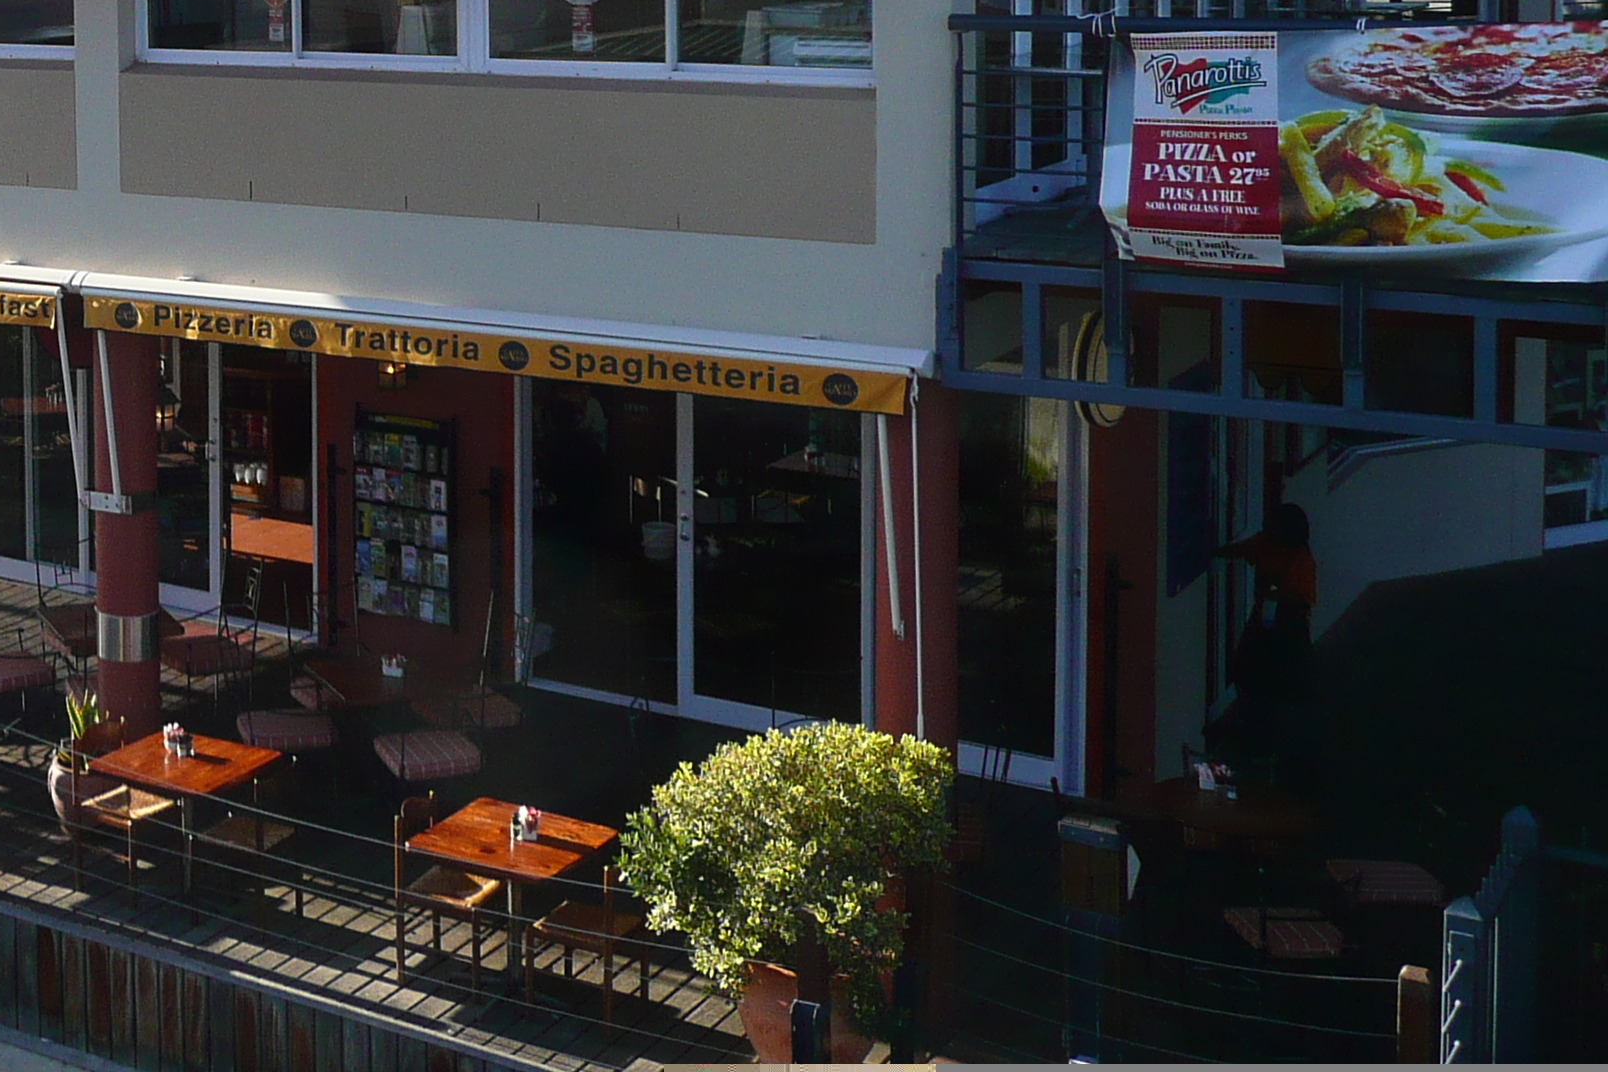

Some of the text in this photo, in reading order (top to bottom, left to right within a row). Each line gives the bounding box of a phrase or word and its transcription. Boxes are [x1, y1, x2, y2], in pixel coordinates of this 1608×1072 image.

[1144, 53, 1262, 104] Panarottis
[1160, 130, 1249, 141] PENSIONER'S PERKS
[1158, 142, 1256, 163] PIZZA or
[1143, 163, 1224, 184] PASTA
[1160, 187, 1246, 203] PLUS A FREE
[1145, 201, 1261, 216] SODA OR GLASS OF WINE
[1152, 236, 1175, 248] Big
[1175, 239, 1193, 248] on
[1176, 247, 1198, 259] Big
[1200, 250, 1218, 258] on
[154, 305, 274, 341] Pizzeria
[335, 322, 480, 362] Trattoria
[548, 344, 801, 396] Spaghetteria
